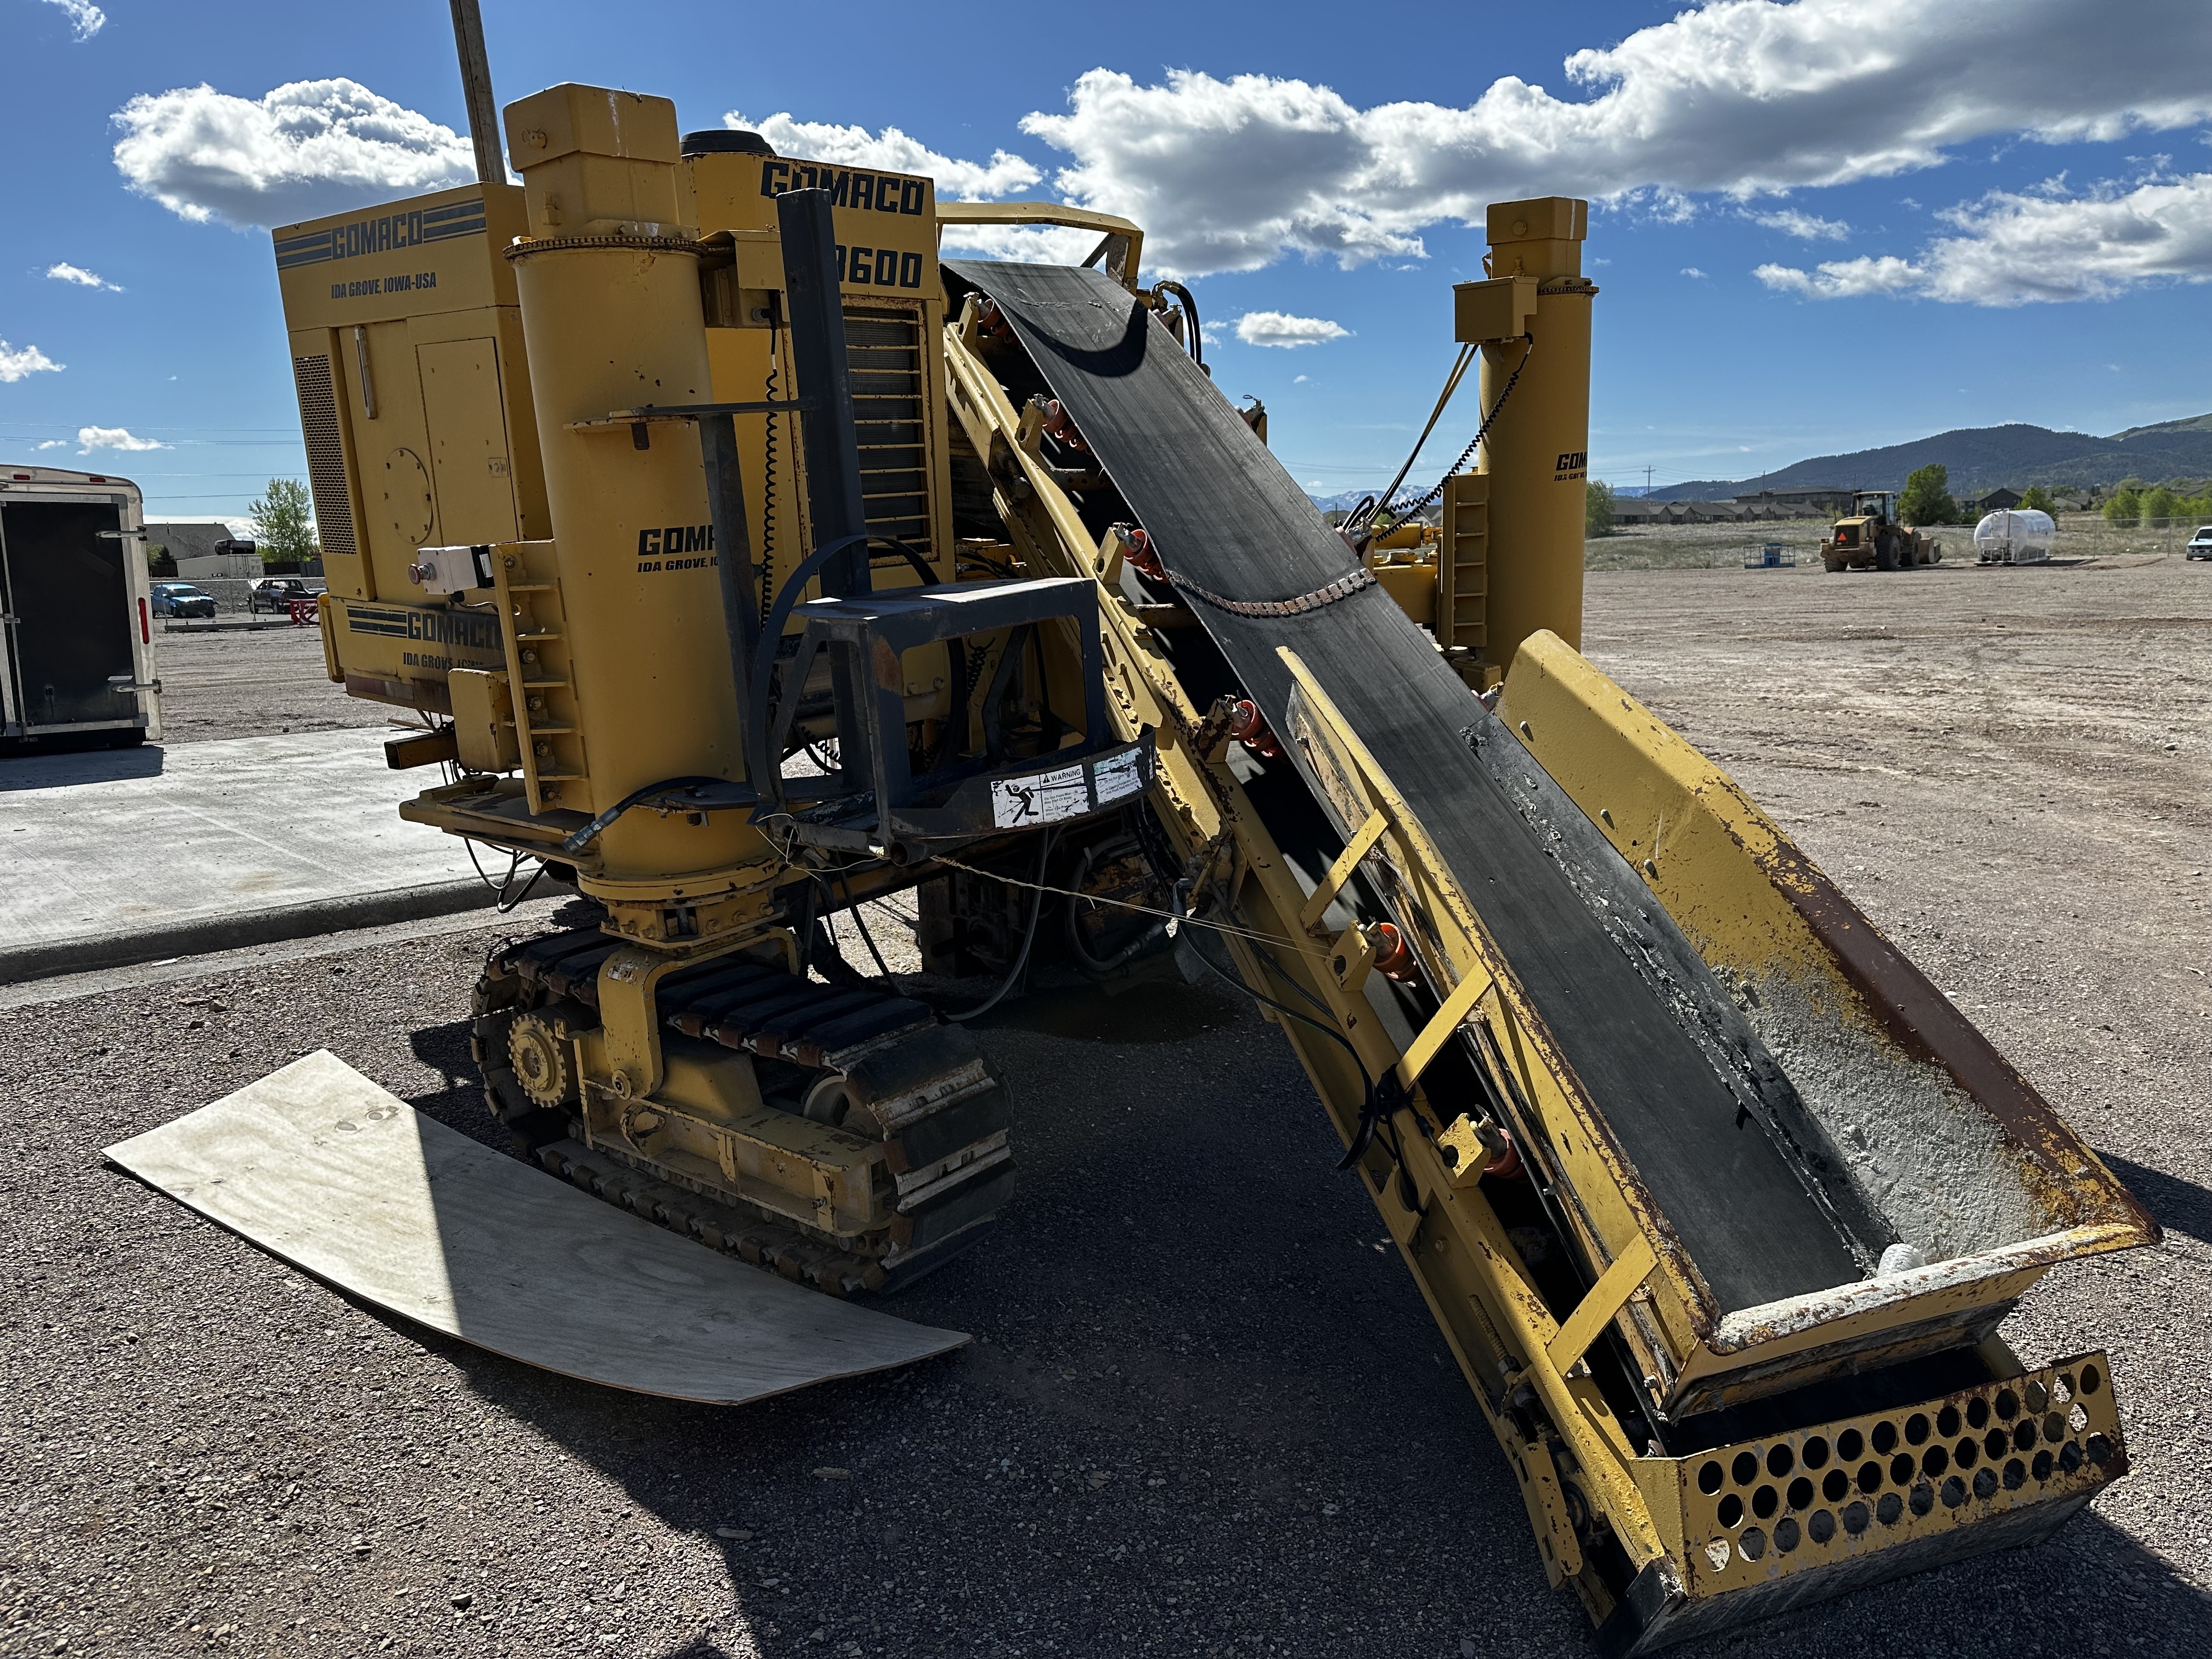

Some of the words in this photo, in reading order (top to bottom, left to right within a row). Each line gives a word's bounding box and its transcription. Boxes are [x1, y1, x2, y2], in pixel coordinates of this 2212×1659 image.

[760, 160, 925, 216] GOMACO
[332, 210, 422, 260] GOMACO
[331, 282, 347, 299] IDA
[349, 279, 382, 296] GROVE,
[384, 272, 437, 293] IOWA-USA
[1556, 451, 1587, 471] GOM
[637, 561, 662, 573] IDA
[665, 557, 708, 571] GROVE,
[403, 652, 419, 667] IDA
[1051, 769, 1081, 782] WARNING
